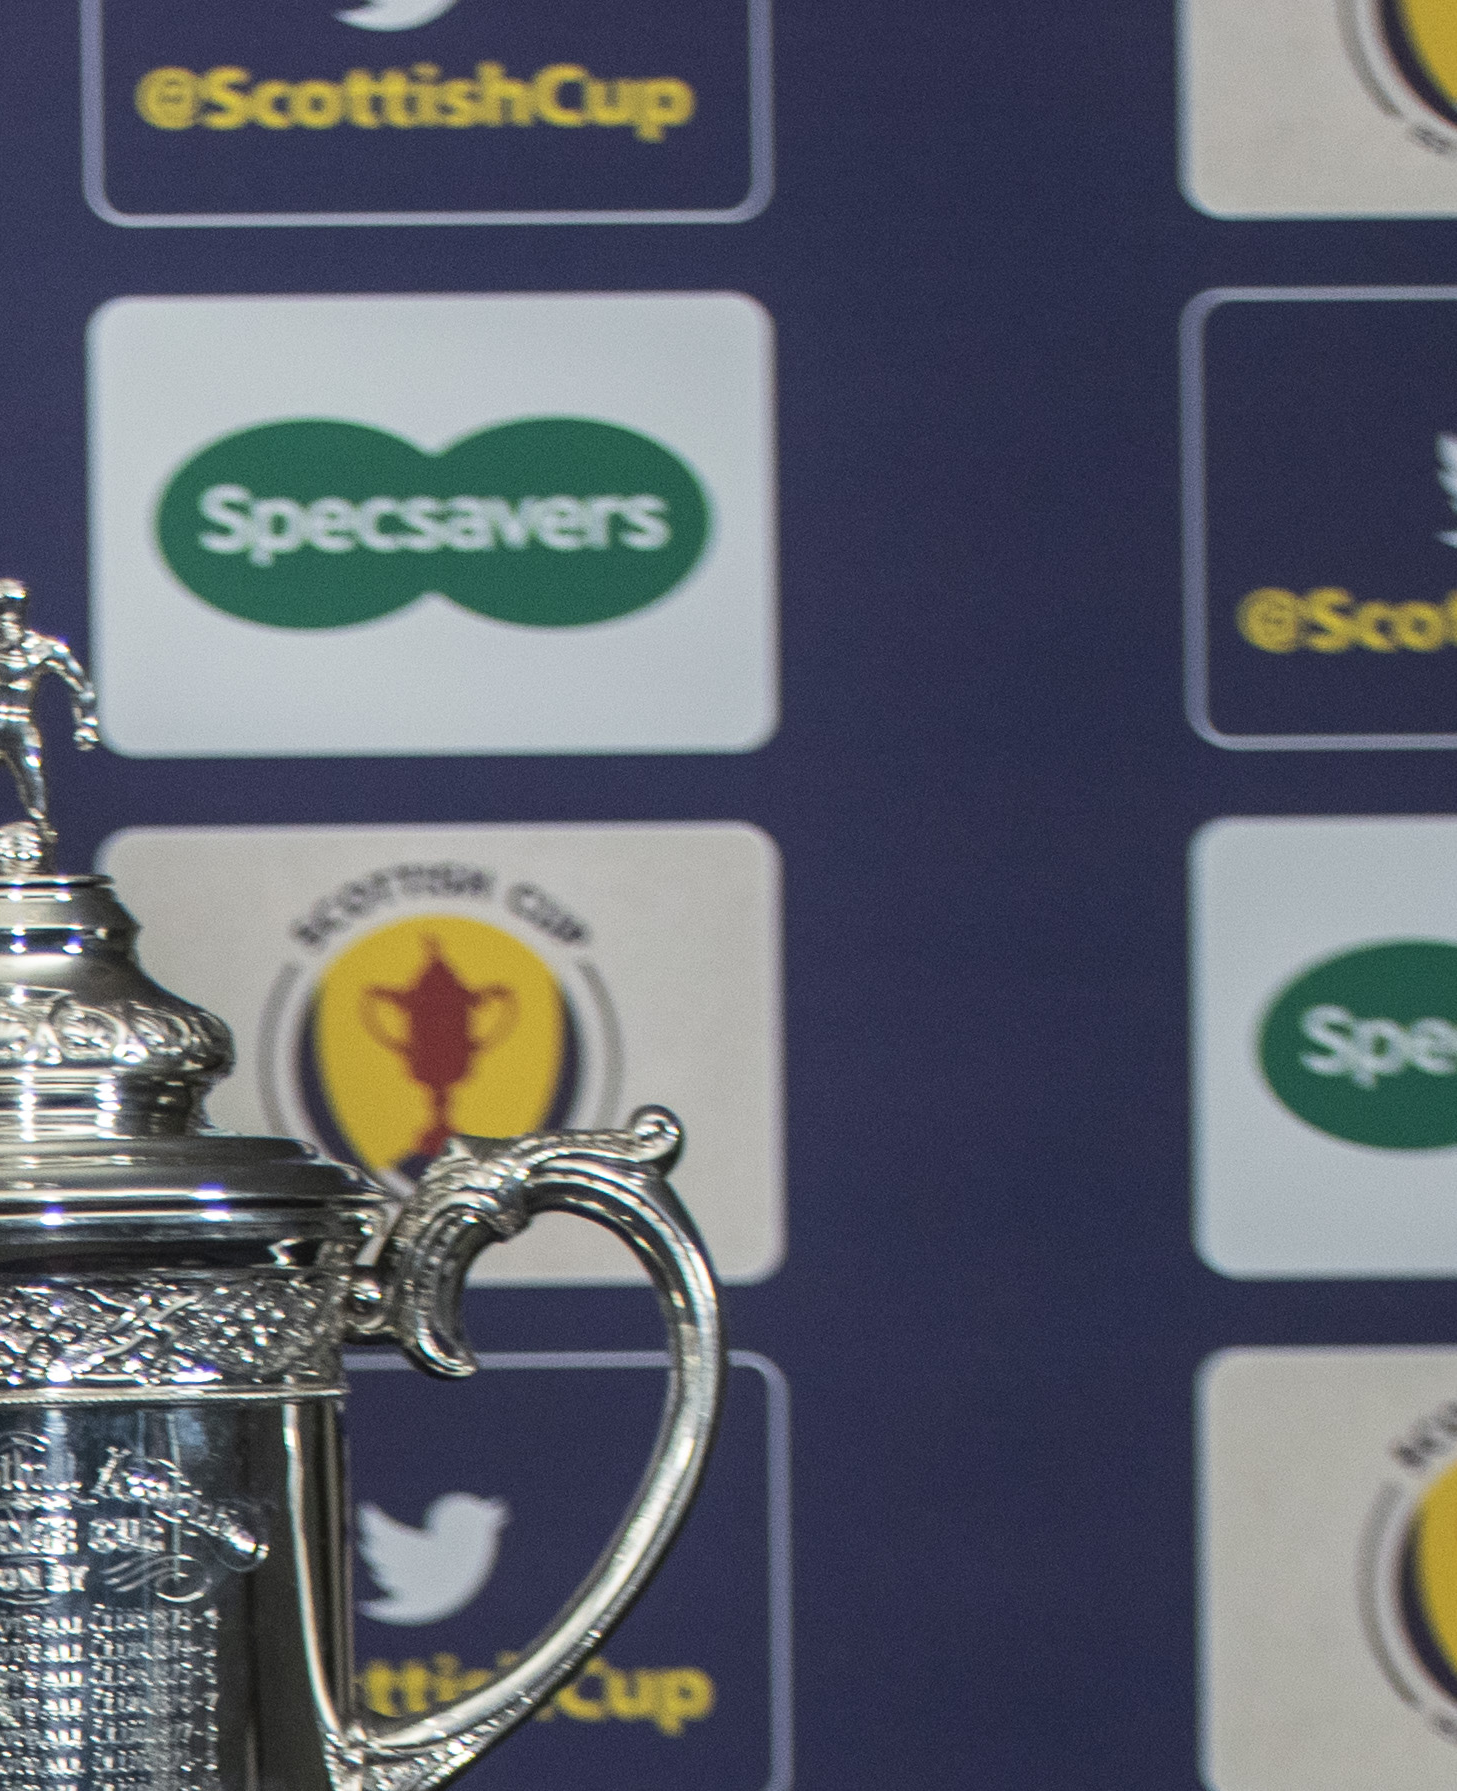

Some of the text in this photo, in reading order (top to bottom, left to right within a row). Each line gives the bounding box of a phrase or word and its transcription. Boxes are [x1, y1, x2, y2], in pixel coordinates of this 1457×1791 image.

[136, 60, 696, 142] @ScottishCup
[199, 482, 672, 567] Specsavers
[288, 861, 593, 957] SCOTTISH CUP
